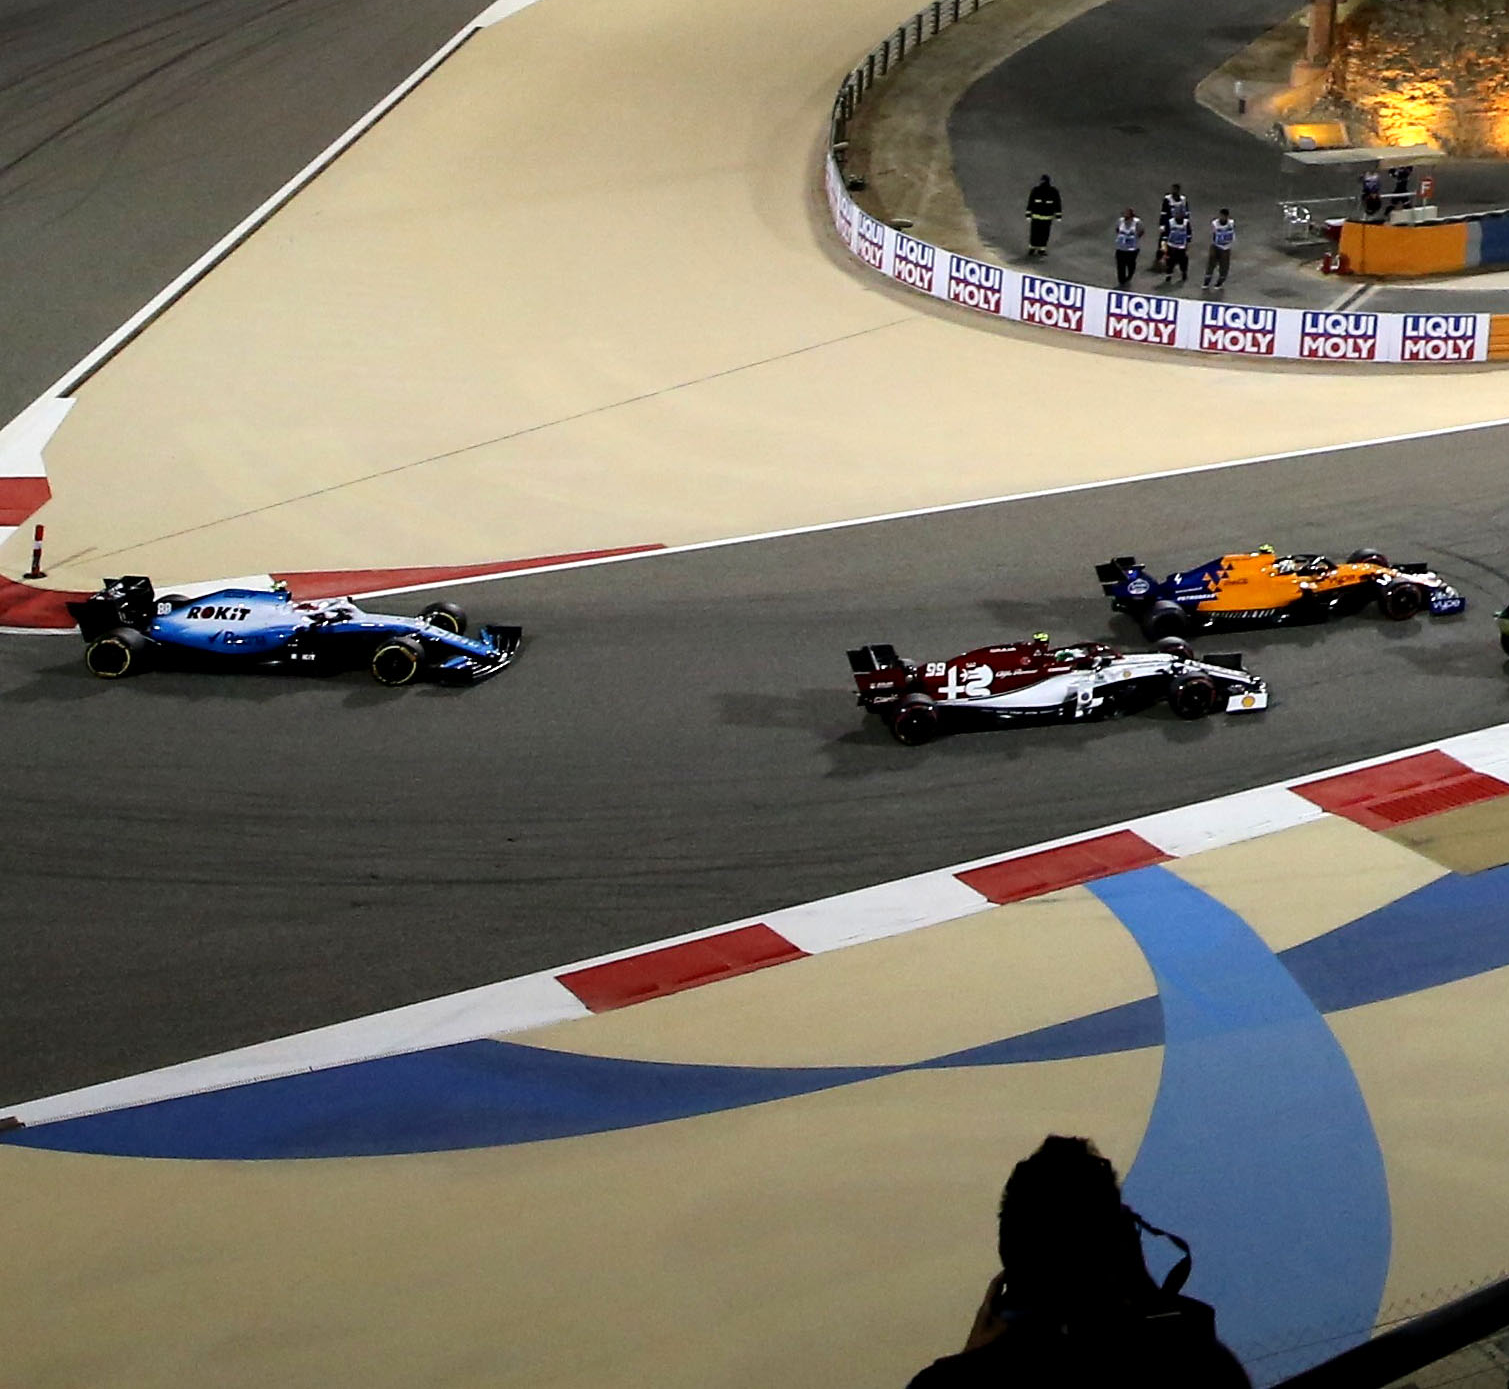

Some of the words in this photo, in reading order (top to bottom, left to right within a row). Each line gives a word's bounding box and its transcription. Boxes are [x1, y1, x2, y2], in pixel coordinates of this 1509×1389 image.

[895, 235, 935, 268] LIQUI
[895, 258, 933, 293] MOLY
[950, 257, 1001, 290] LIQUI
[950, 281, 1000, 313] MOLY
[1023, 277, 1084, 308] LIQUI
[1022, 300, 1083, 332] MOLY
[1108, 293, 1178, 321] LIQUI
[1203, 305, 1275, 330] LIQUI
[1107, 316, 1176, 345] MOLY
[1304, 313, 1376, 337] LIQUI
[1405, 315, 1476, 339] LIQUI
[1201, 327, 1275, 354] MOLY
[1302, 336, 1375, 359] MOLY
[1403, 338, 1475, 360] MOLY
[1174, 573, 1183, 585] 4
[925, 662, 946, 677] 99
